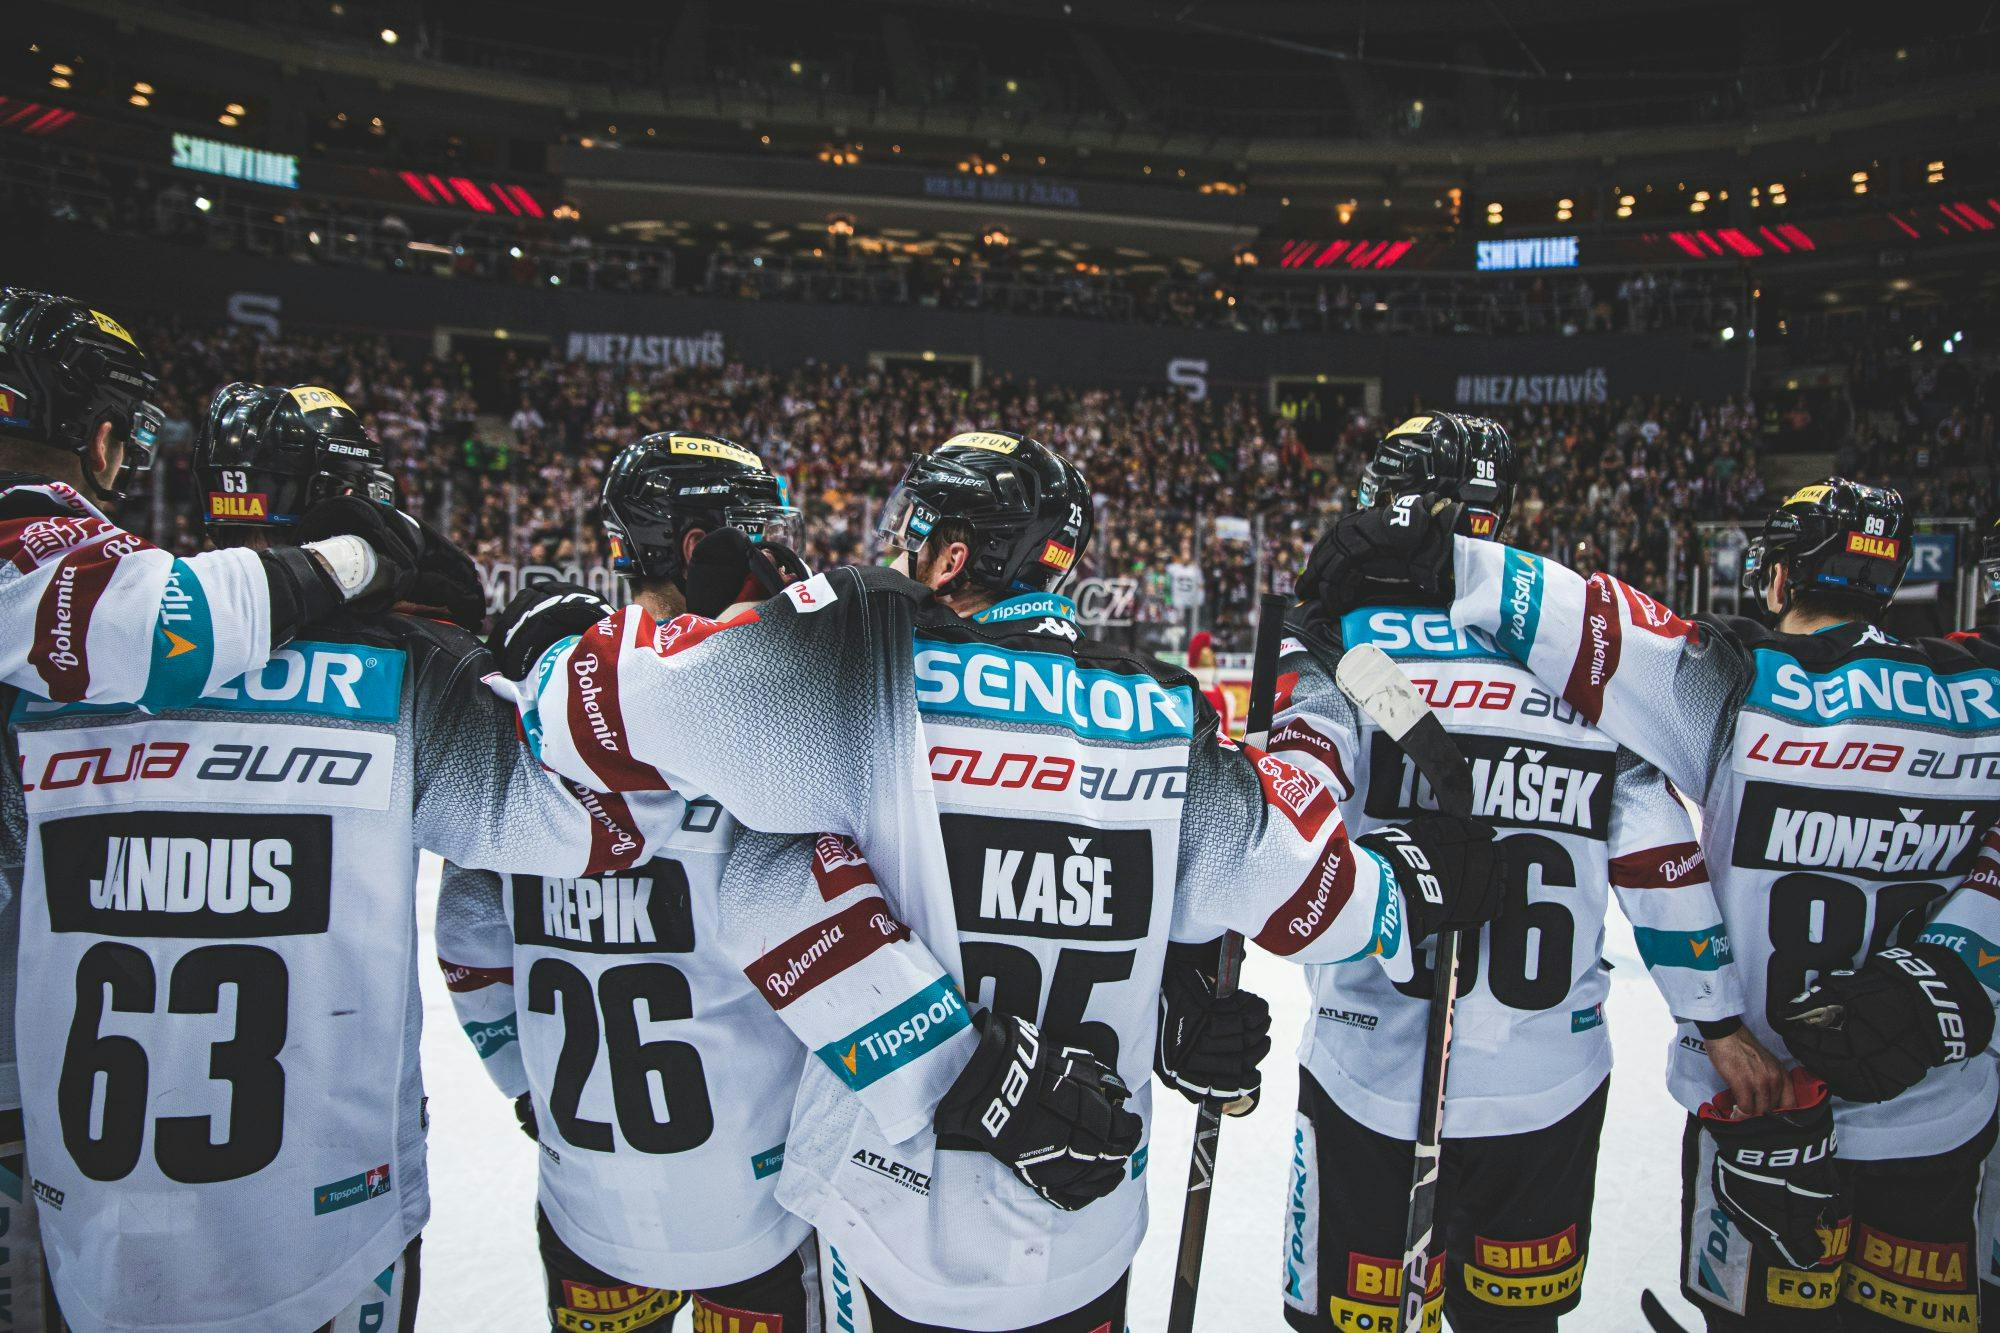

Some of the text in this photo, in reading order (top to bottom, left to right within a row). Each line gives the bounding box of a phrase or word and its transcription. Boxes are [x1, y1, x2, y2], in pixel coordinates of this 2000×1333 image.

[173, 132, 299, 189] SHOWTIME
[1476, 236, 1579, 271] SHOWTIME
[299, 391, 343, 406] FORT
[328, 443, 369, 458] BAUER
[222, 470, 248, 493] 63
[939, 472, 984, 488] BAUER
[1476, 460, 1495, 480] 96
[212, 497, 265, 516] BILLA
[679, 485, 730, 496] BAUER
[1068, 502, 1082, 527] 25
[1865, 515, 1884, 536] 89
[1043, 544, 1075, 569] BILL
[1850, 535, 1895, 558] BILLA
[48, 566, 78, 671] Bohemia
[991, 600, 1054, 620] Tipsport
[1508, 567, 1536, 641] Tipsport
[1588, 613, 1609, 686] Bohemia
[573, 653, 619, 752] Bohemia
[914, 649, 1184, 733] SENCOR
[929, 746, 1075, 792] OUDA
[1765, 807, 1975, 873] KONEČNÝ
[90, 836, 292, 914] JANDUS
[979, 836, 1113, 927] KAŠE
[1289, 852, 1340, 938] Bohemia
[766, 924, 844, 998] Bohemia
[1318, 1006, 1379, 1027] ATLETICO
[1877, 947, 1965, 1063] BAUER
[472, 1024, 514, 1052] port
[860, 988, 961, 1063] Tipsport
[58, 941, 289, 1184] 63
[528, 957, 714, 1155] 26
[981, 1015, 1041, 1138] BAU
[1019, 1145, 1055, 1159] SUPREME
[1737, 1129, 1839, 1168] BAUE
[32, 1178, 65, 1206] ETICO
[329, 1182, 363, 1203] Tipsport
[895, 1178, 930, 1198] SPORTSWEA
[1291, 1127, 1308, 1265] DAIKIN
[1482, 1235, 1572, 1270] BILLA
[1863, 1234, 1965, 1283] BILLA
[1356, 1263, 1441, 1297] BIA
[1472, 1273, 1581, 1299] FORTUNA
[565, 1290, 680, 1333] FORTUNA
